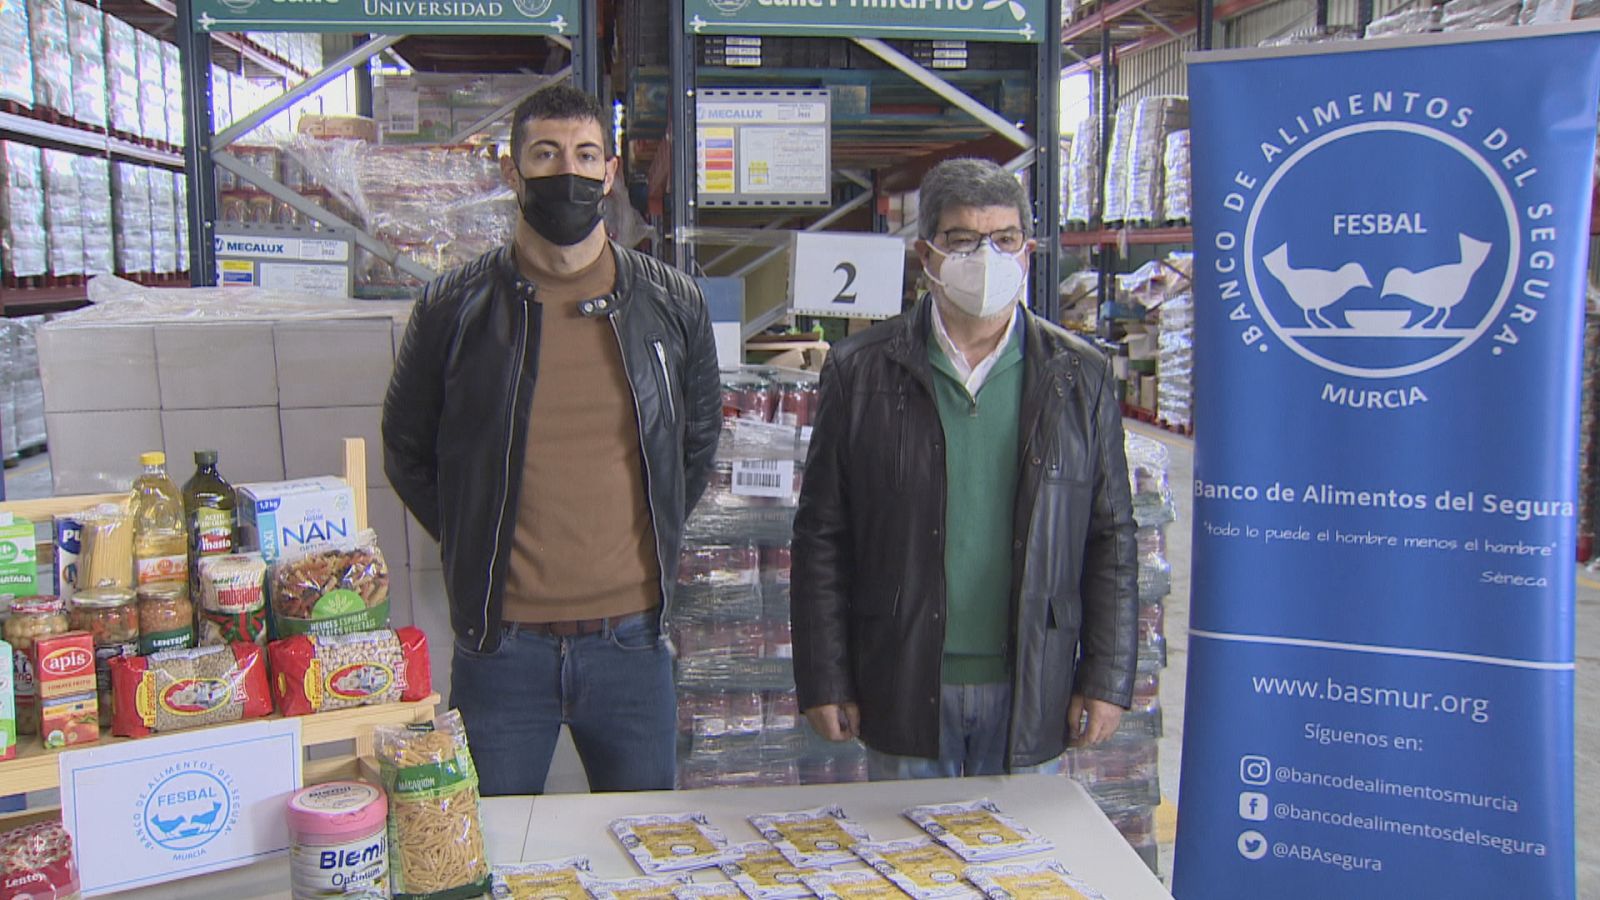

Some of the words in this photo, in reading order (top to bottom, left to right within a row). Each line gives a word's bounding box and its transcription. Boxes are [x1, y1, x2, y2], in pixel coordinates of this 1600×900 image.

[363, 0, 503, 17] UNIVERSIDAD
[708, 109, 763, 119] MECALUX
[1260, 91, 1473, 163] ALIMENTOS
[1482, 127, 1538, 188] DEL
[1223, 170, 1257, 213] DE
[1333, 212, 1428, 235] FESBAL
[227, 242, 284, 254] MECALUX
[831, 261, 858, 304] 2
[1214, 230, 1265, 346] BANCO
[1492, 202, 1556, 347] SEGURA
[1321, 382, 1429, 410] MURCIA
[1193, 479, 1258, 502] Banco
[1266, 482, 1296, 503] de
[1301, 484, 1428, 510] Alimentos
[1434, 486, 1474, 513] del
[1482, 494, 1575, 522] Segura
[282, 517, 347, 547] NAN
[1246, 524, 1260, 538] lo
[1264, 526, 1311, 544] puede
[1316, 529, 1330, 543] el
[1335, 530, 1398, 547] hombre
[1403, 536, 1458, 550] menos
[1464, 538, 1479, 552] el
[49, 651, 86, 672] apis
[1252, 675, 1490, 723] www.basmur.org
[1303, 722, 1388, 749] Síguenos
[1393, 734, 1424, 752] en:
[157, 786, 217, 807] FESBAL
[1274, 765, 1519, 813] @bancodealimentosmurcia
[1273, 802, 1546, 857] @bancodealimentosdelsegura
[172, 847, 207, 861] MURCIA
[319, 834, 387, 870] Blemil
[1272, 841, 1382, 872] @ABAsegura
[331, 866, 381, 890] Optimum
